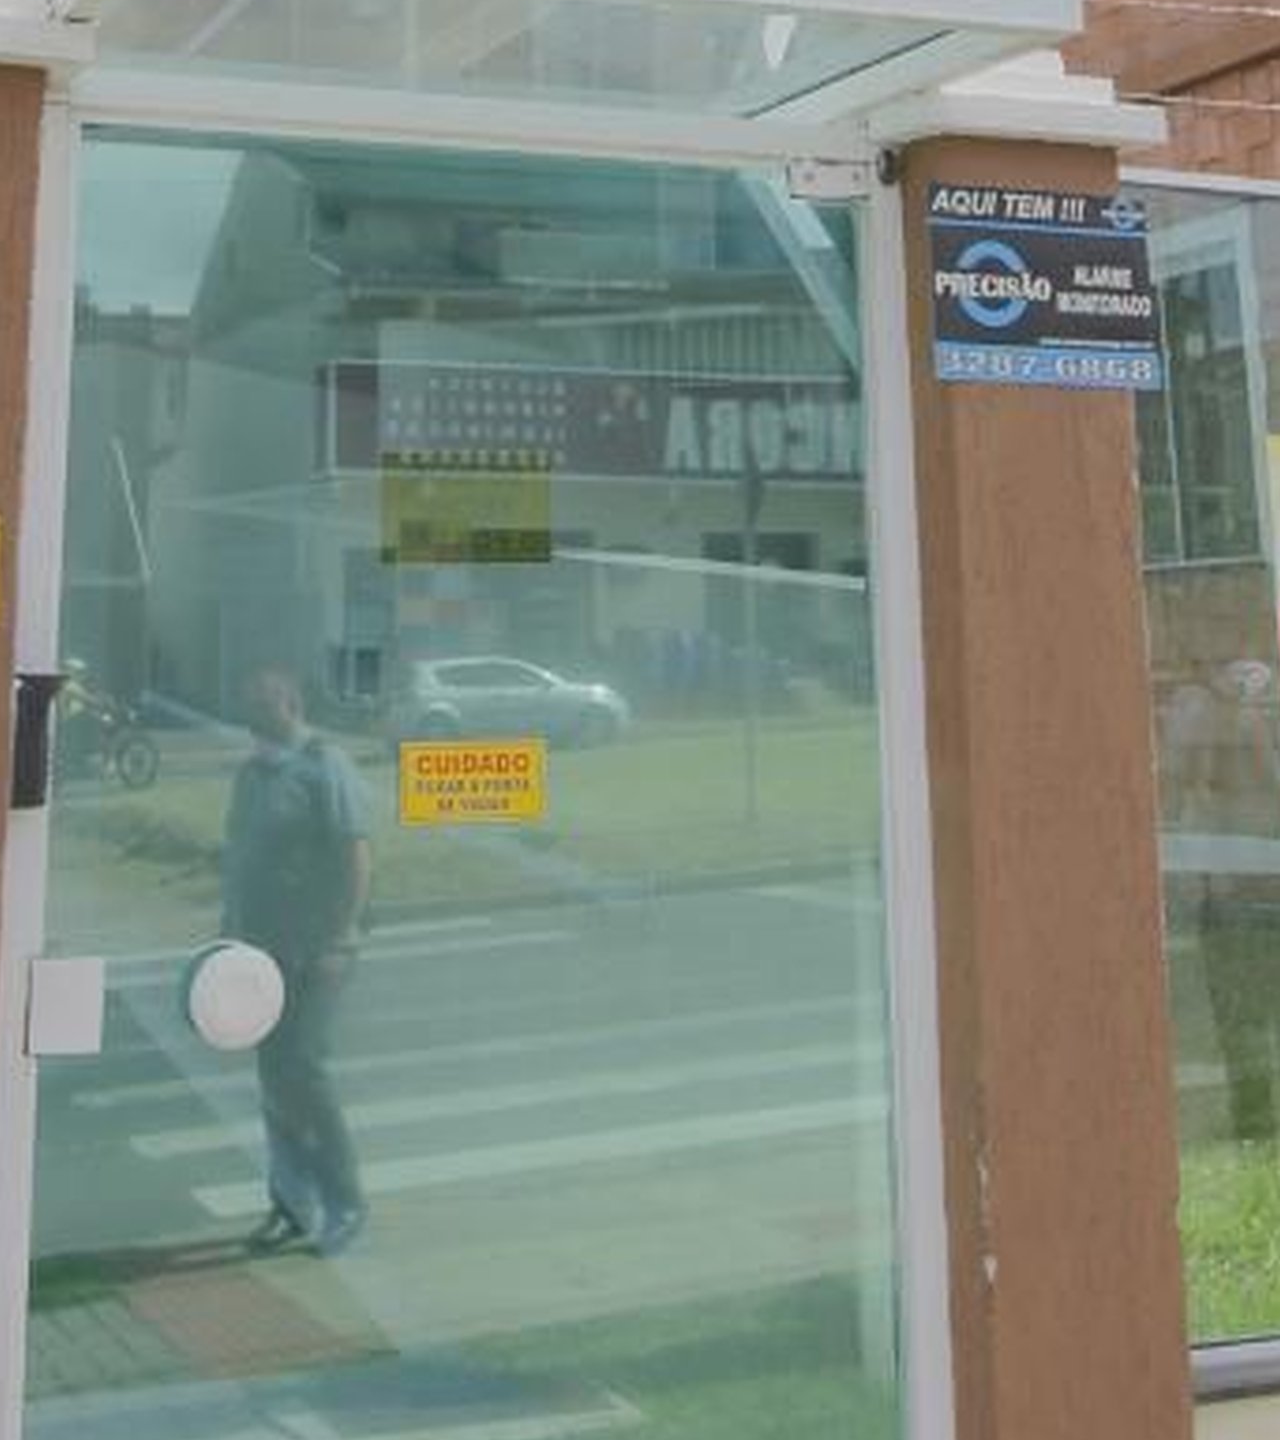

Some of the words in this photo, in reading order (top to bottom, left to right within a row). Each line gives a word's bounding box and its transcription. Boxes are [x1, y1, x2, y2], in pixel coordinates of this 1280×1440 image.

[932, 189, 995, 216] AQUI
[1002, 193, 1054, 220] TEM
[934, 269, 1052, 301] PRECISÃO
[416, 752, 530, 776] CUIDADO
